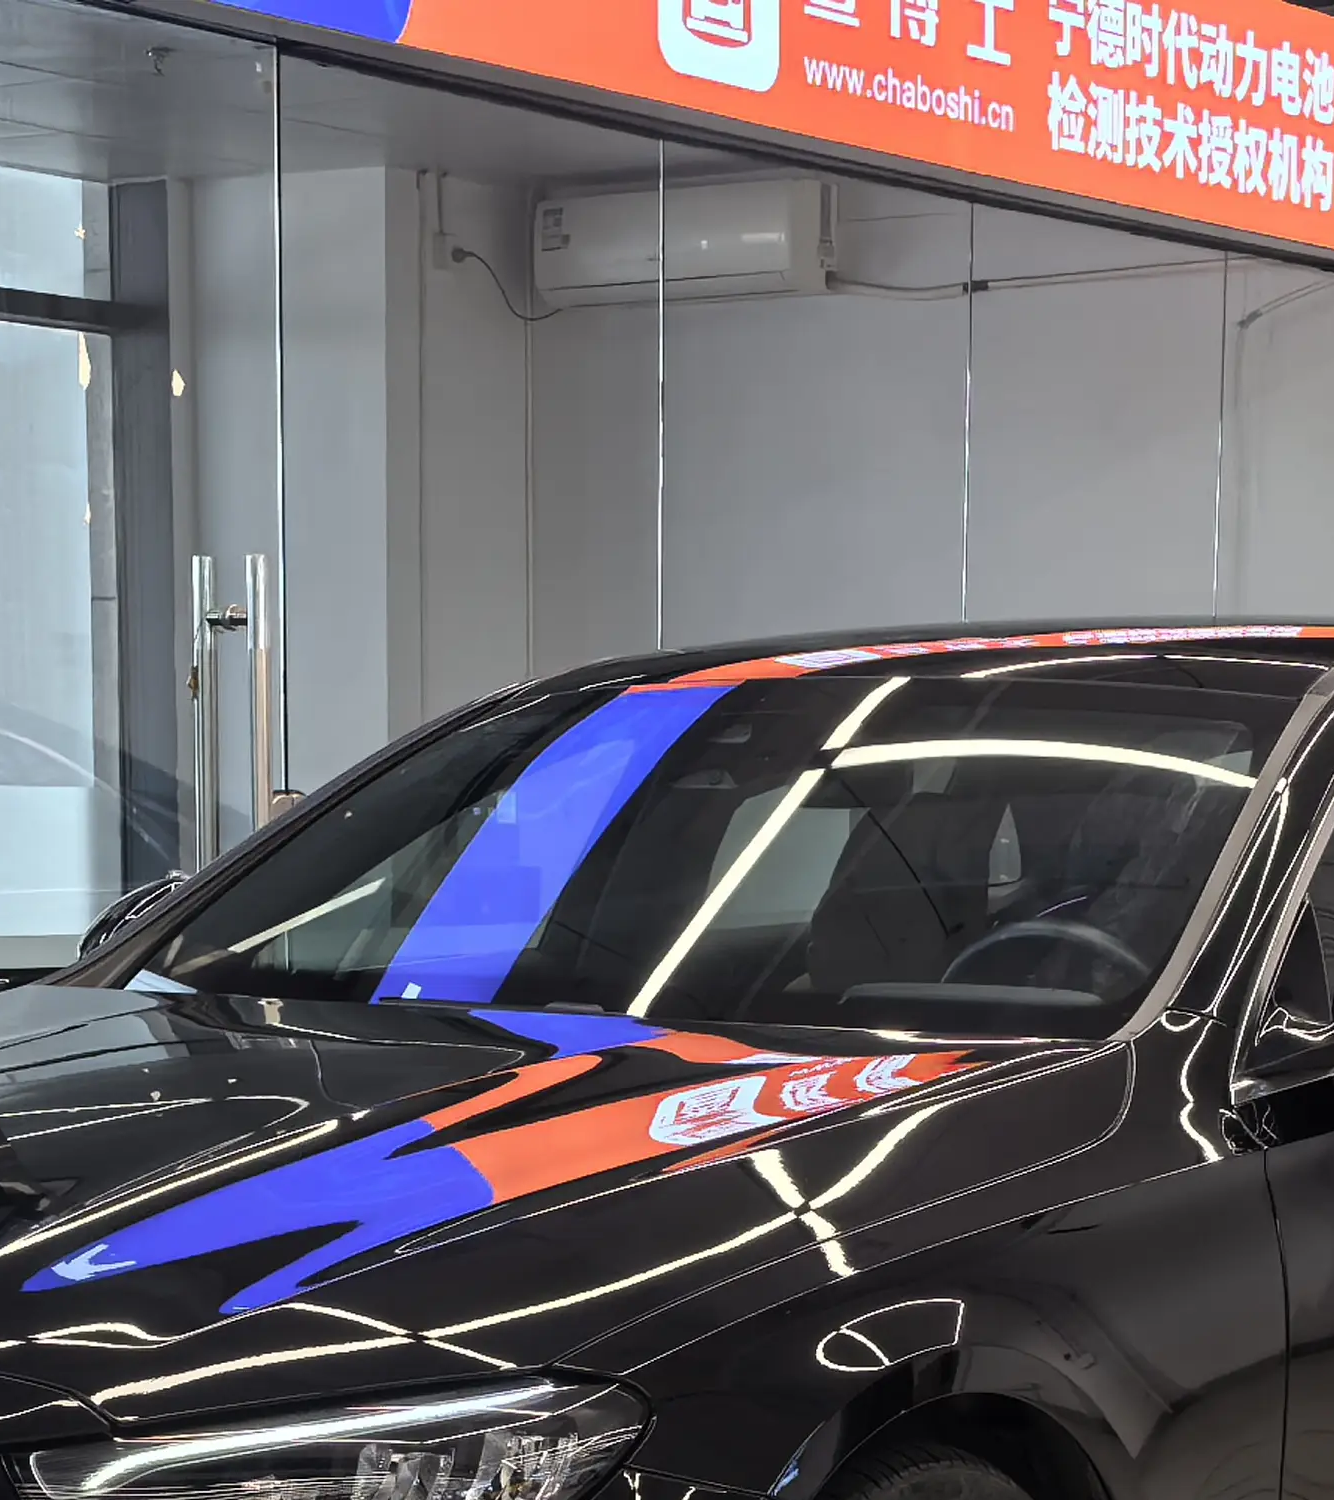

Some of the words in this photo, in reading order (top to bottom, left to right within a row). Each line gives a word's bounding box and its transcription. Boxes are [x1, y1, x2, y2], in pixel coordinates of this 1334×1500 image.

[803, 56, 1015, 132] www.chaboshi.cn
[1047, 71, 1334, 211] 检测技术授权机构
